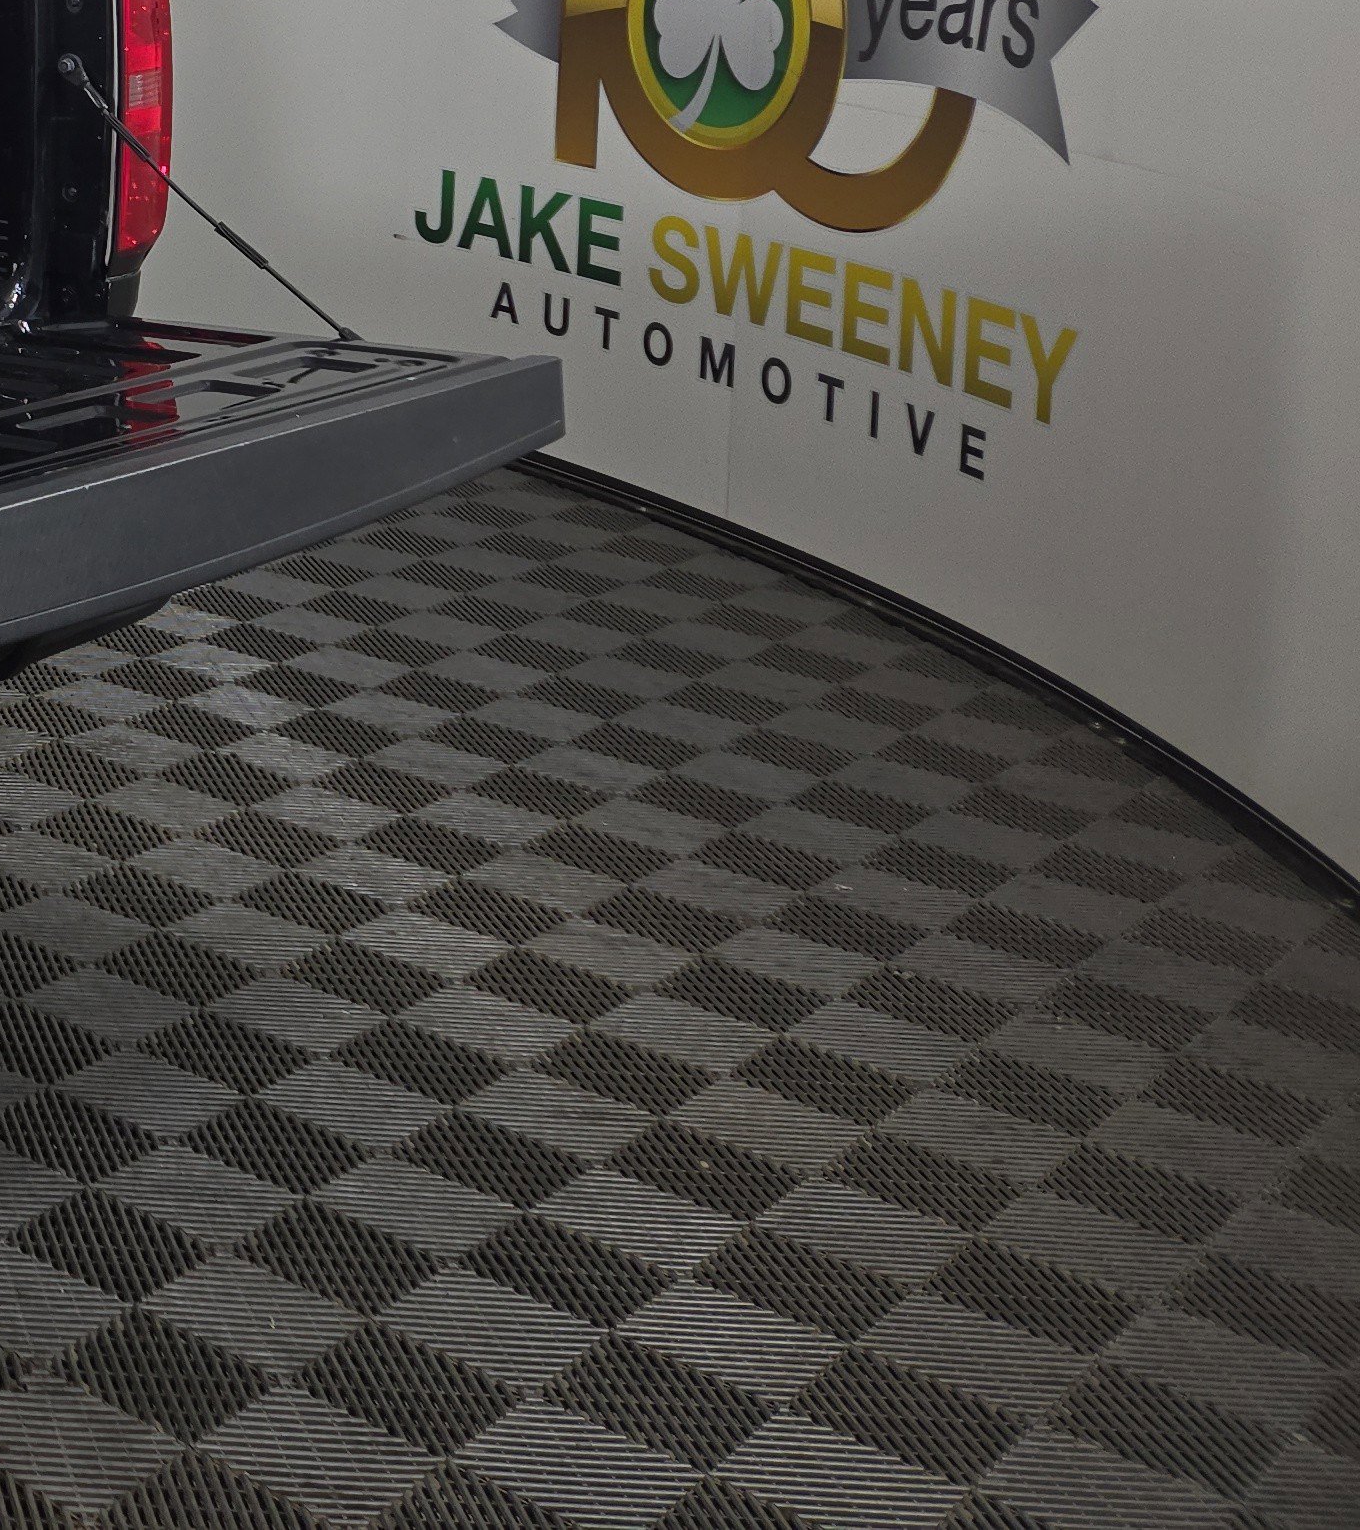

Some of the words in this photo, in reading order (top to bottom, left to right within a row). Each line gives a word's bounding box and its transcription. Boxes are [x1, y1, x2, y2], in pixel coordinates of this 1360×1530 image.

[414, 169, 623, 286] JAKE
[648, 215, 1077, 425] SWEENEY
[490, 281, 987, 481] AUTOMOTIVE
